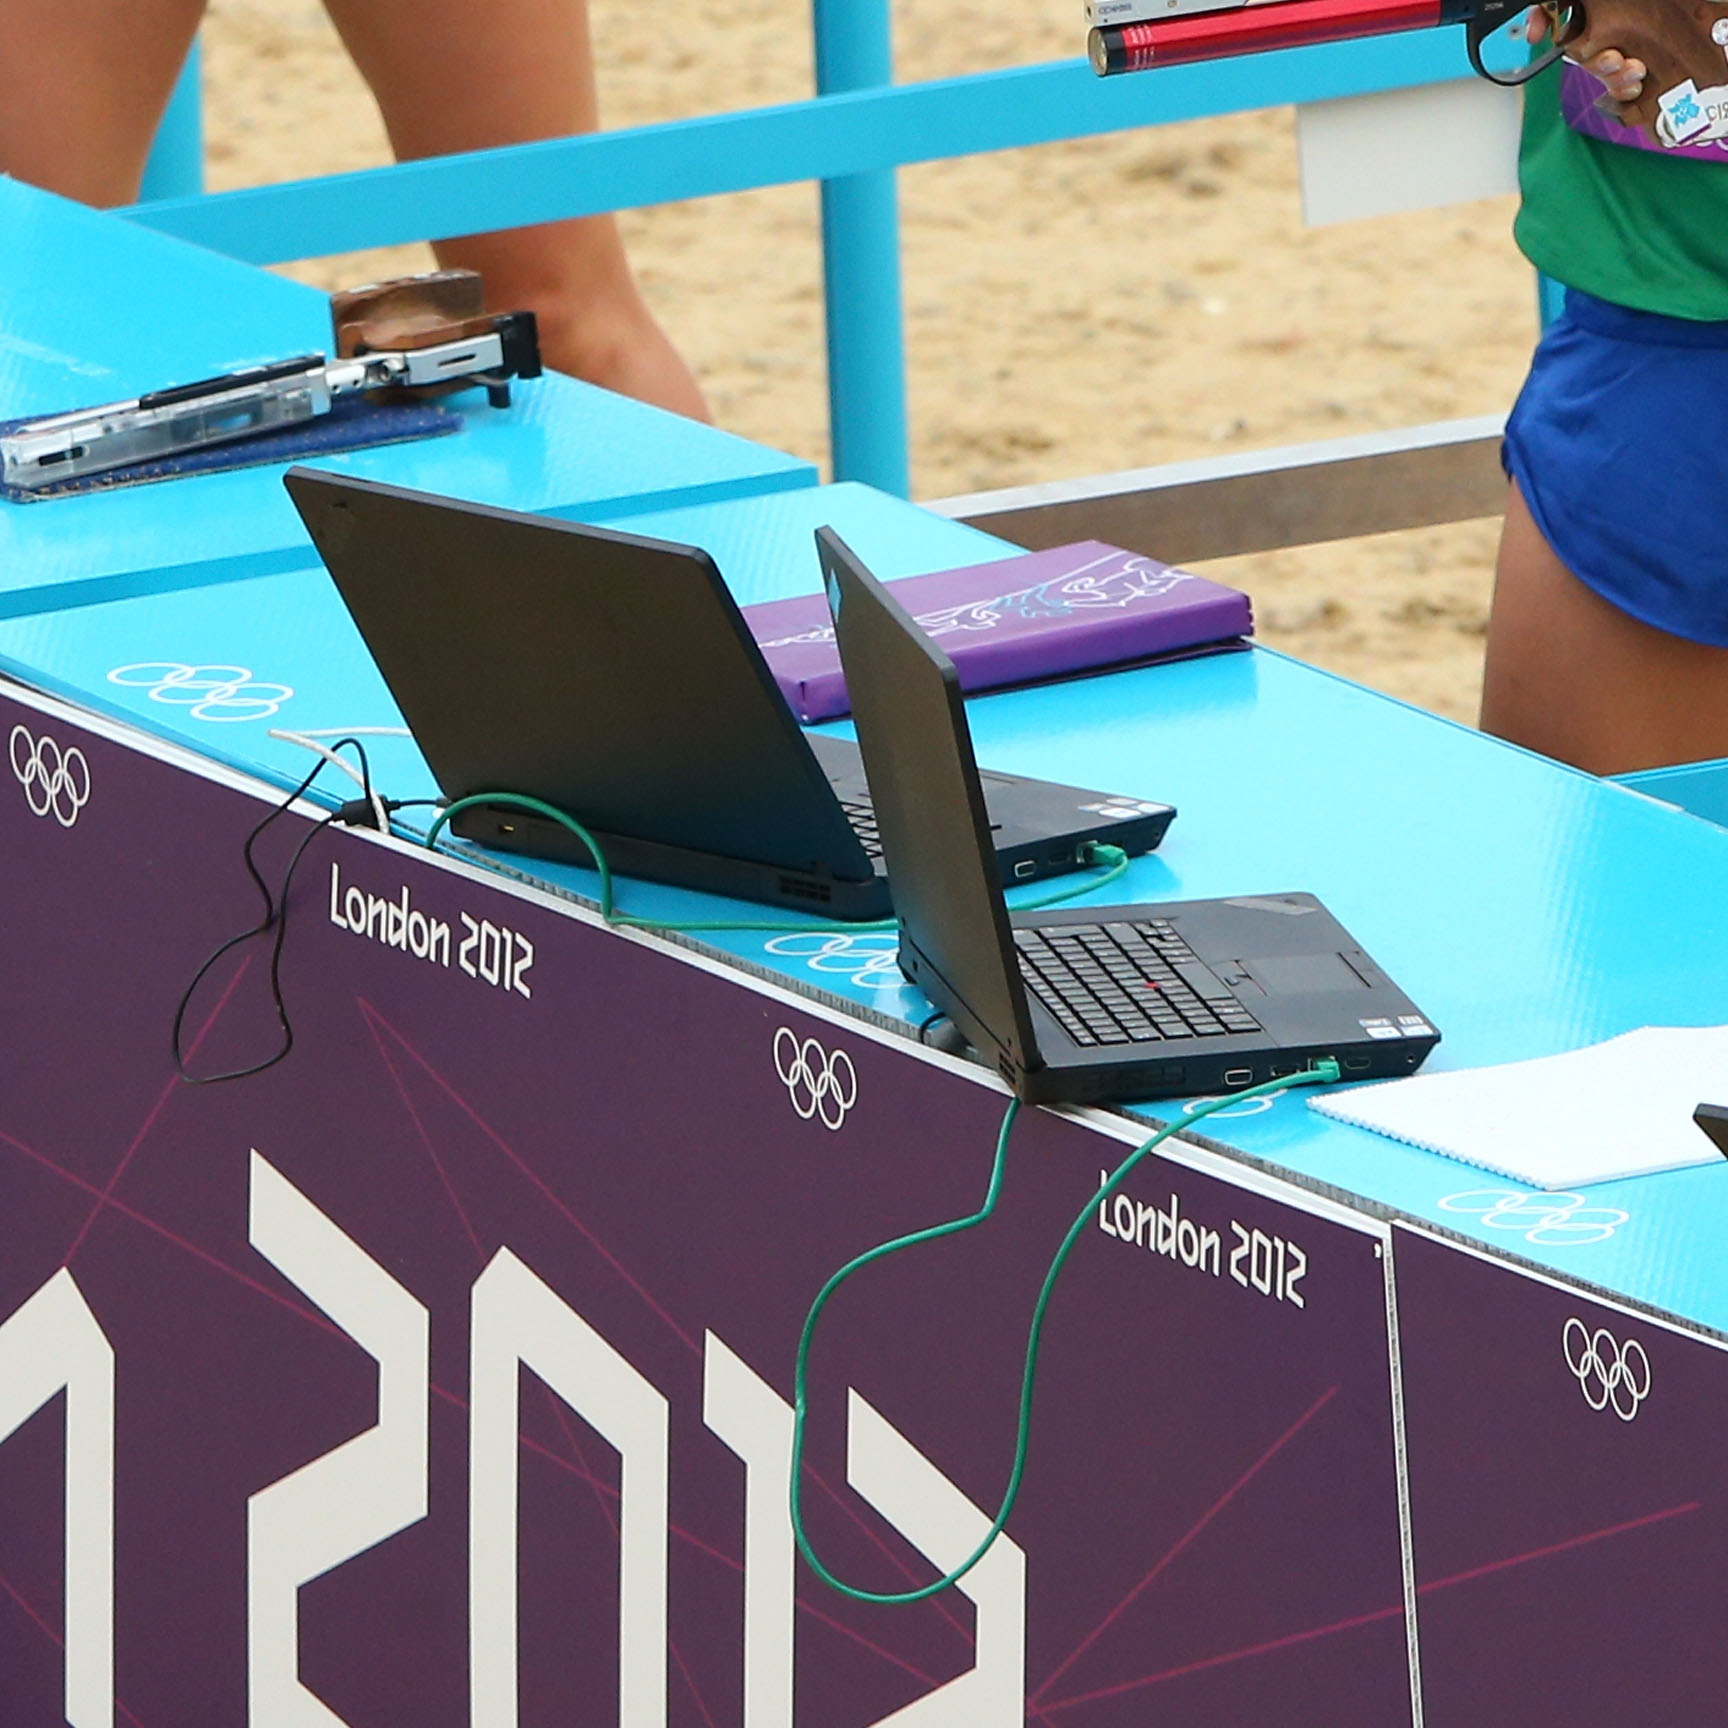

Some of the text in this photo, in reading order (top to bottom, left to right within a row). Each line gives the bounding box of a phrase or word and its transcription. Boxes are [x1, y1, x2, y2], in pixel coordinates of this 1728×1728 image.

[330, 862, 535, 1000] London 2012
[1099, 1168, 1307, 1310] London 2012
